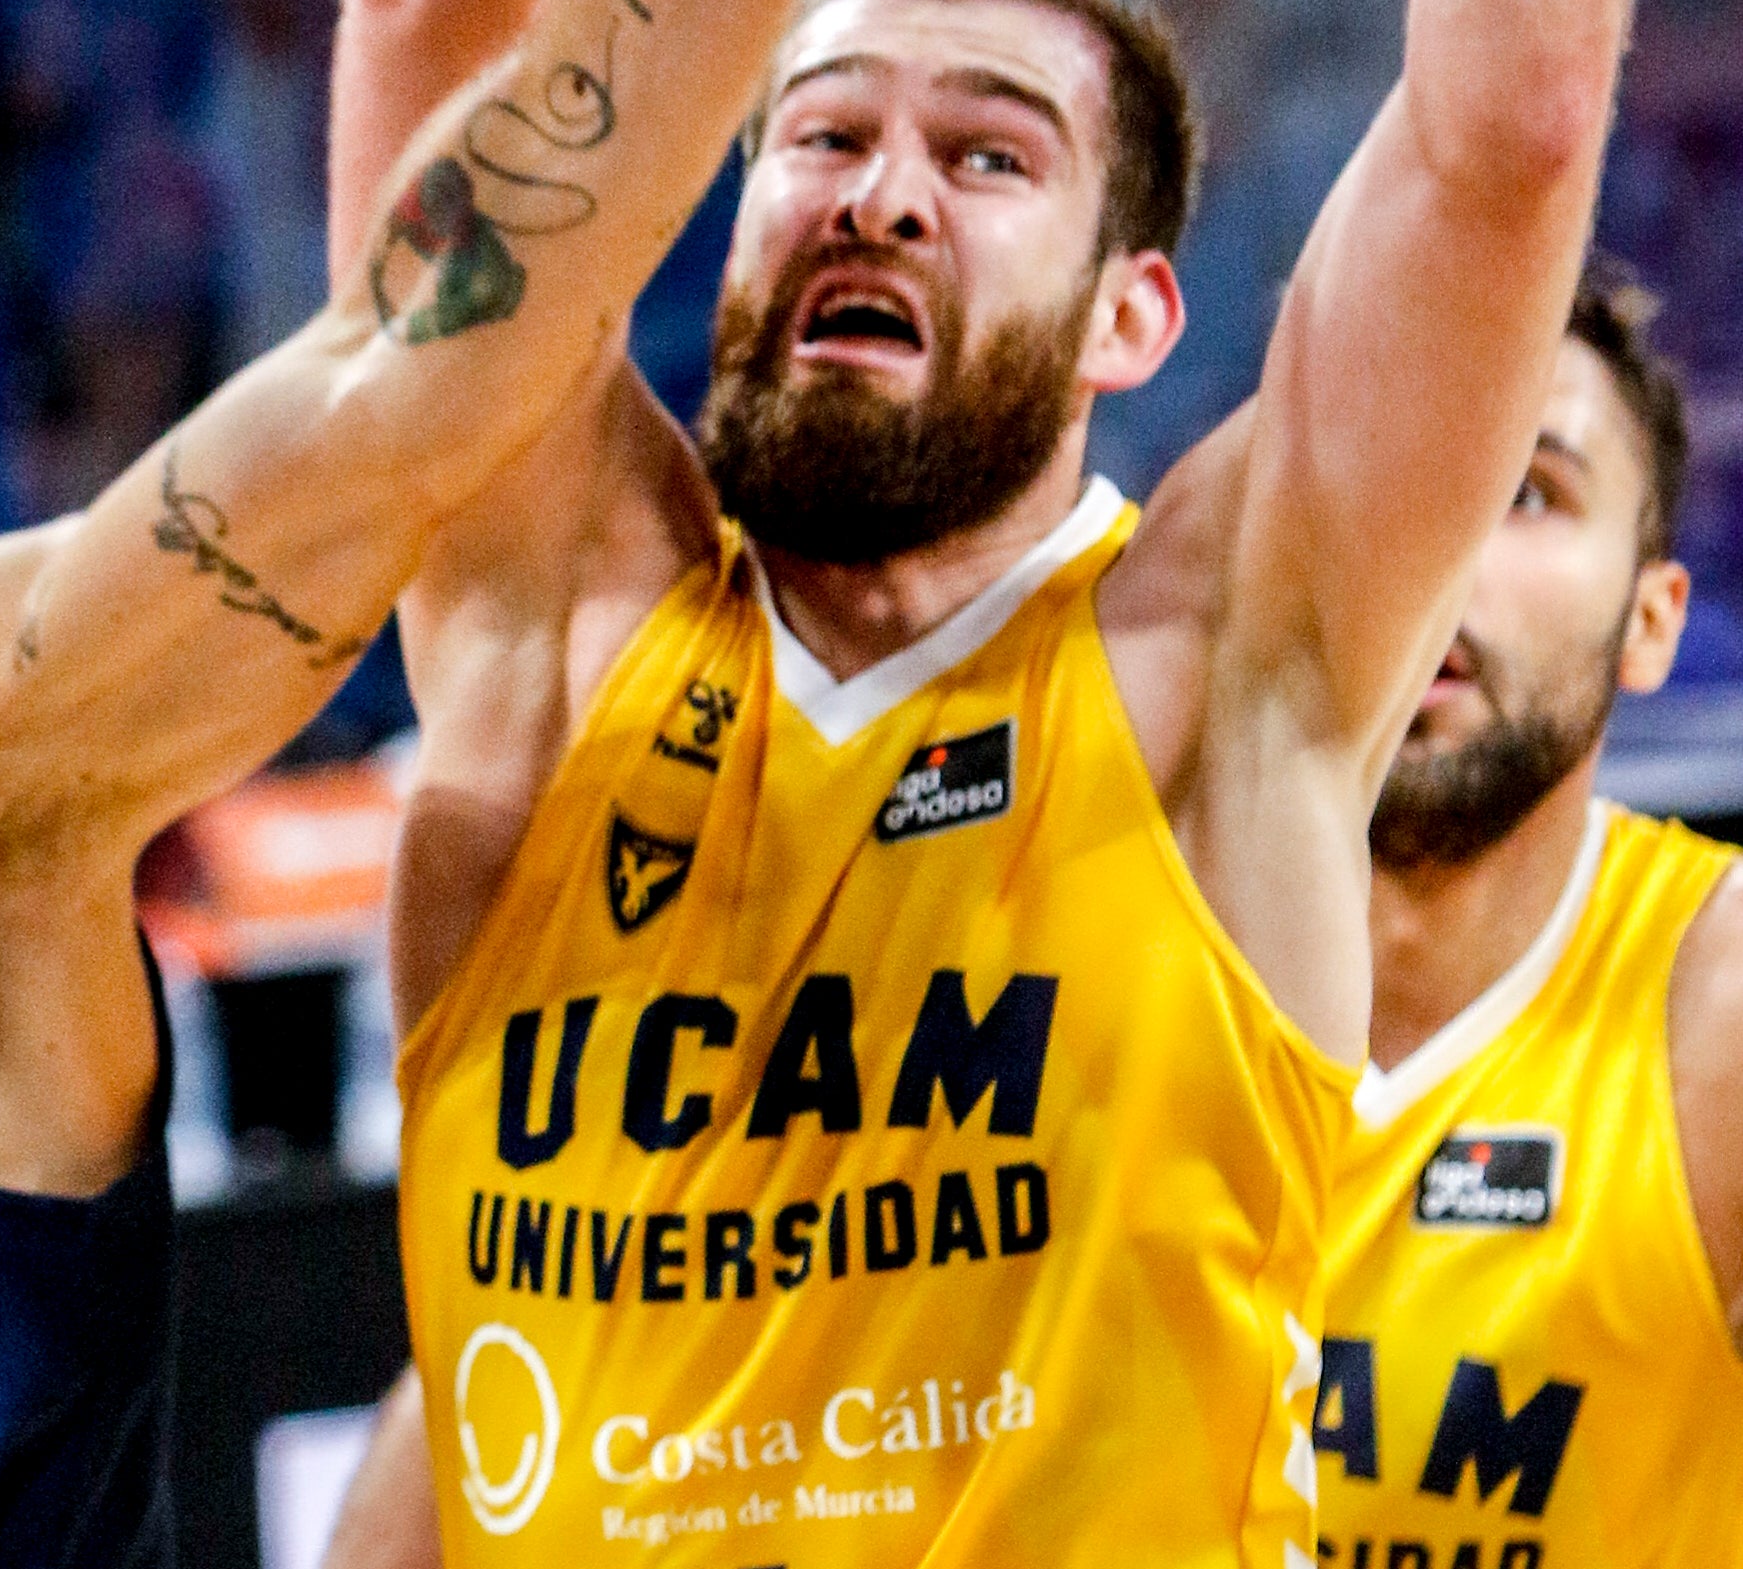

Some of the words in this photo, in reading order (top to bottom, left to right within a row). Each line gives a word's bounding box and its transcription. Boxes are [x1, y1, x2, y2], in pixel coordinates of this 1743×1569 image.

[497, 970, 1060, 1172] UCAM
[467, 1161, 1052, 1305] UNIVERSIDAD
[590, 1412, 804, 1486] Costa
[736, 1490, 782, 1527] de
[792, 1482, 917, 1521] Murcia
